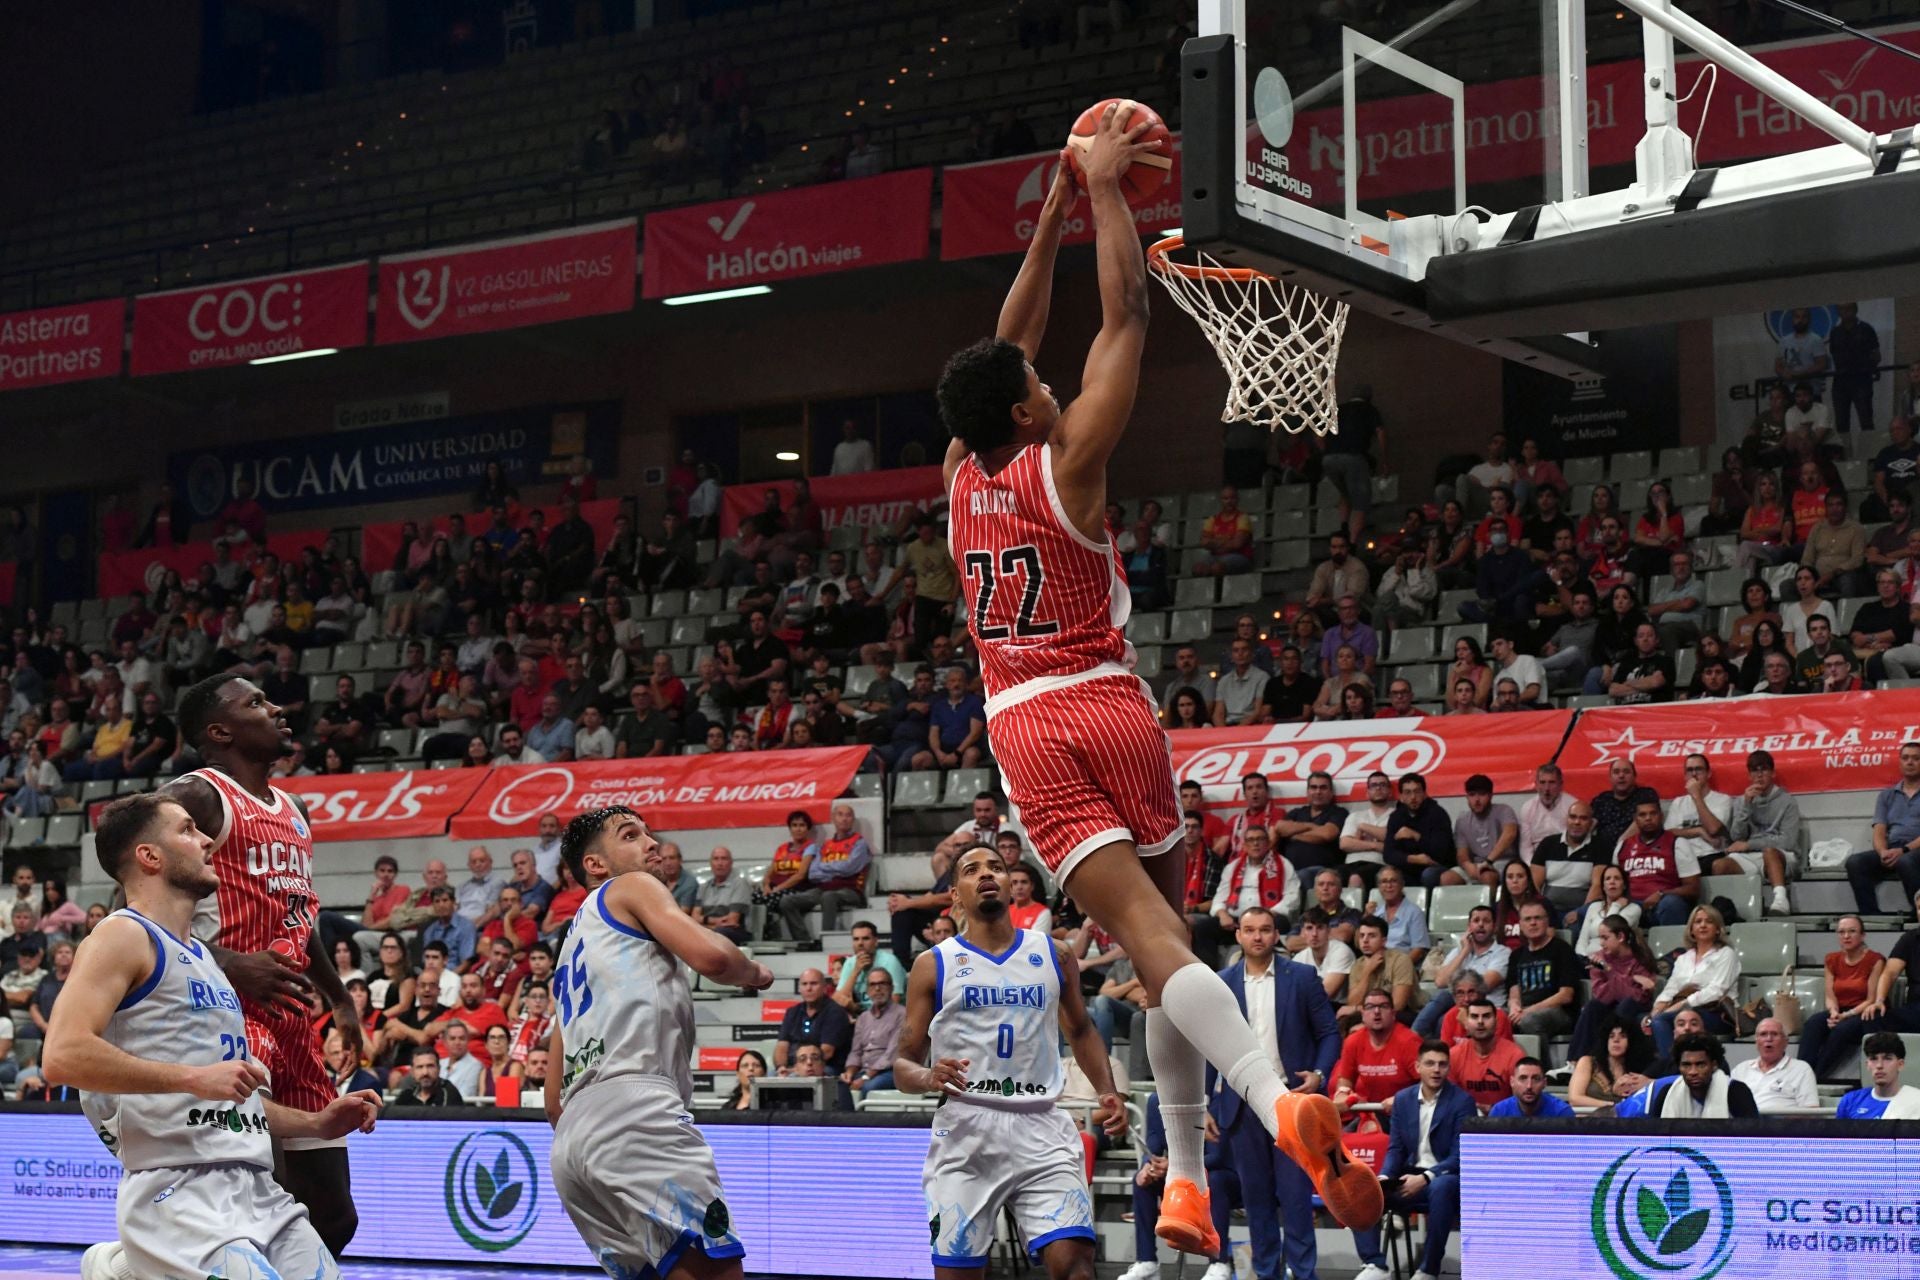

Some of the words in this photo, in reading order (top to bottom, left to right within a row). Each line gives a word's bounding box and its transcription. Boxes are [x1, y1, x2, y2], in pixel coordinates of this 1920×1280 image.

[479, 255, 613, 295] GASOLINERAS
[707, 243, 808, 281] Halcón
[812, 244, 862, 266] viajes
[0, 313, 91, 345] Asterra
[0, 347, 102, 380] Partners
[1551, 409, 1628, 427] Ayuntamiento
[1579, 425, 1617, 440] Murcia
[374, 428, 526, 466] UNIVERSIDAD
[444, 463, 468, 481] DE
[965, 544, 1060, 642] 22
[1655, 727, 1864, 757] ESTRELLA
[1869, 731, 1899, 741] DE
[575, 786, 673, 809] REGIÓN
[674, 786, 713, 803] DE
[714, 781, 818, 803] MURCIA
[1624, 856, 1665, 872] UCAM
[963, 984, 1045, 1010] RILSKI
[997, 1023, 1014, 1059] 0
[14, 1159, 40, 1178] OC
[1766, 1199, 1811, 1222] OC
